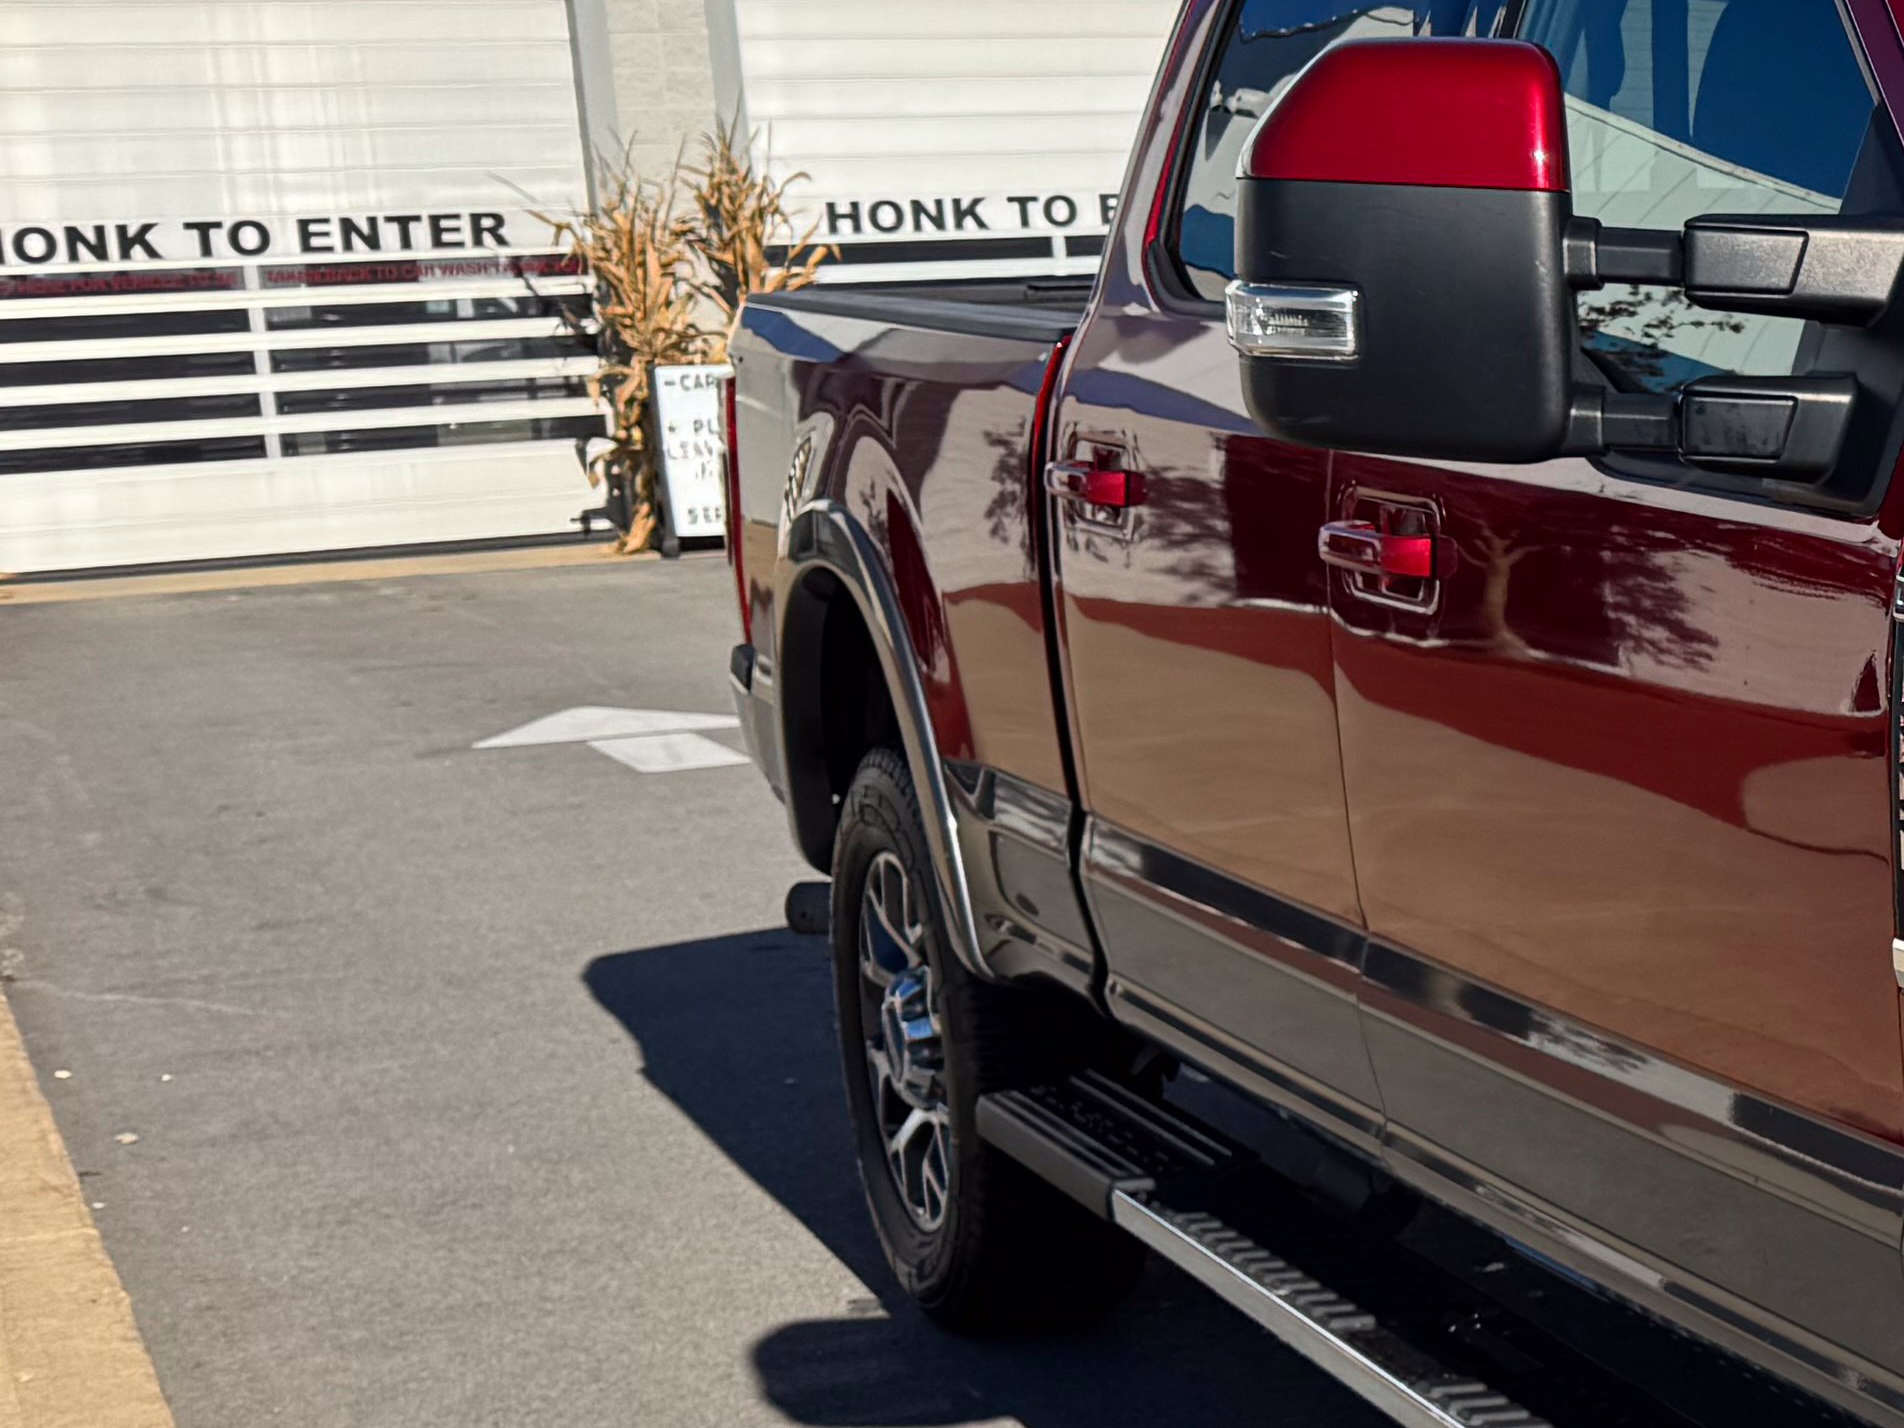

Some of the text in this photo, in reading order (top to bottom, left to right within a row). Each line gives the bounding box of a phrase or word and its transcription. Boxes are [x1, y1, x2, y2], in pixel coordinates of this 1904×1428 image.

[825, 196, 990, 234] HONK
[1007, 194, 1078, 229] TO
[0, 212, 510, 265] ONK TO ENTER
